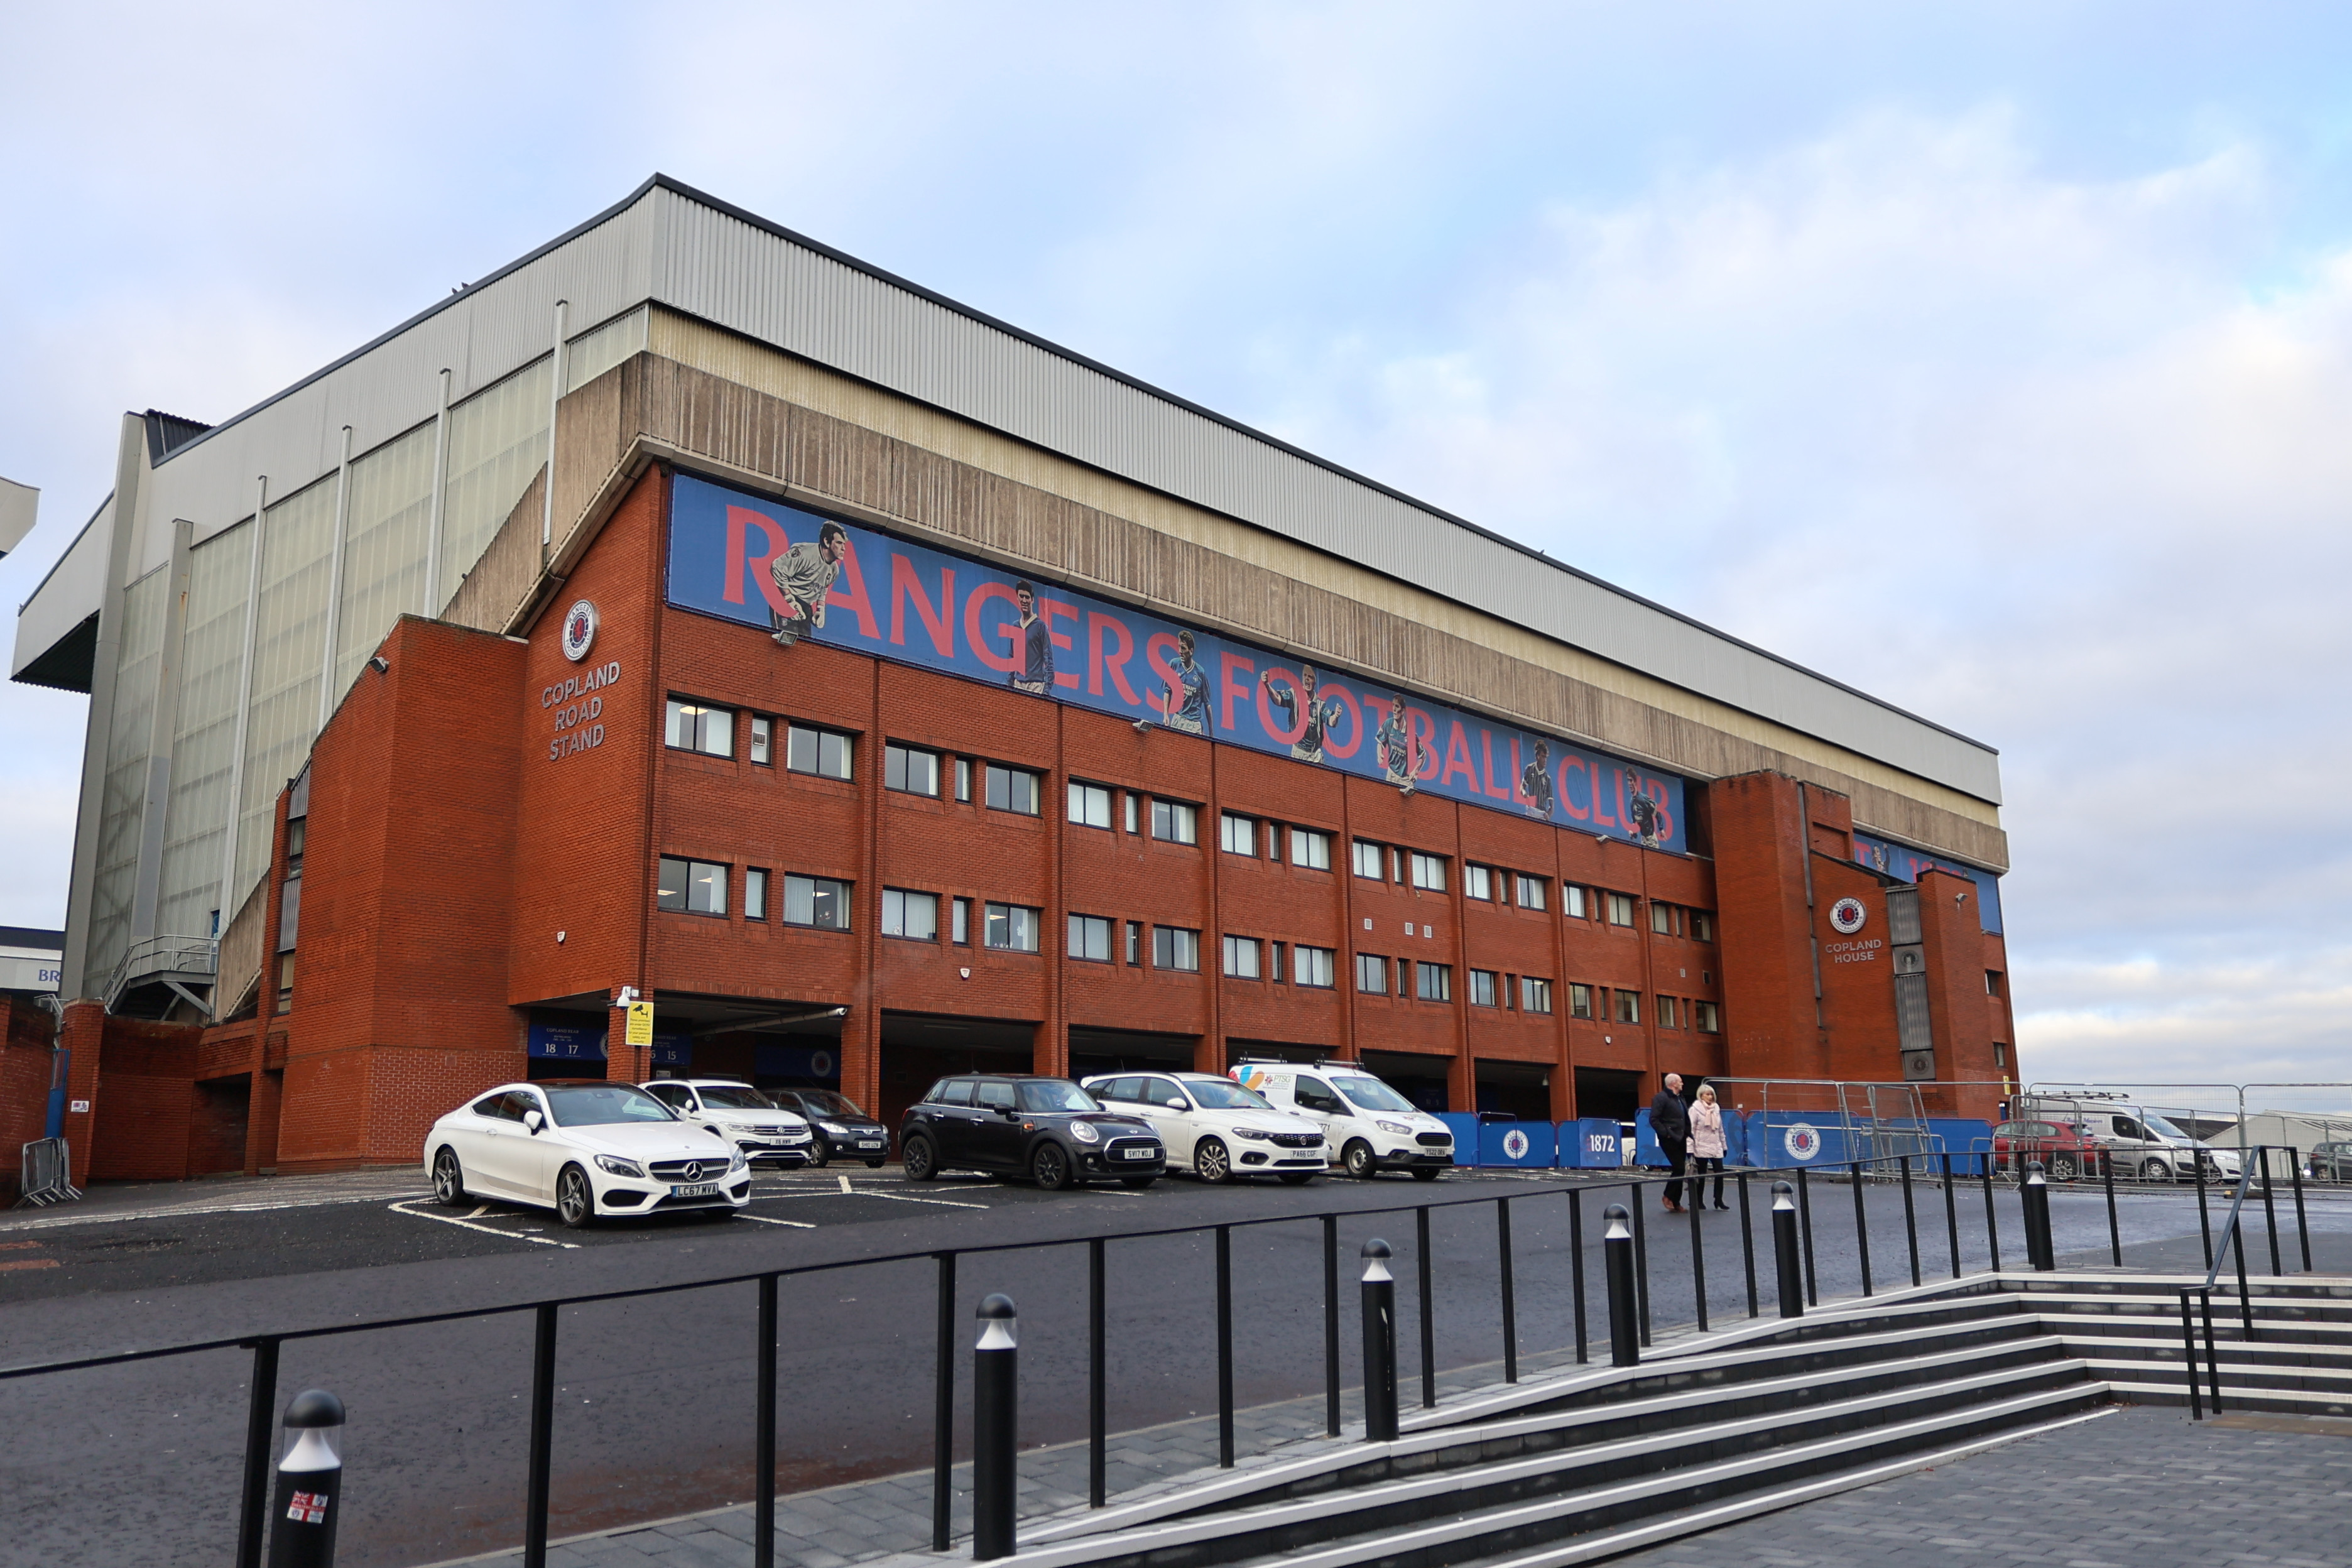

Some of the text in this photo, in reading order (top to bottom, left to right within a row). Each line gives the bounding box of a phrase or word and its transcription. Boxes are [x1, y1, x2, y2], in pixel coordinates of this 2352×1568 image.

[568, 604, 591, 624] RANGERS
[722, 504, 1673, 841] RANGERS FOOTBALL CLUB
[542, 662, 620, 708] COPLAND
[555, 697, 602, 731] ROAD
[550, 724, 605, 761] STAND
[1835, 899, 1859, 910] RANGERS
[1834, 918, 1855, 930] FOOTBALL
[1825, 939, 1882, 953] COPLAND
[1834, 951, 1875, 963] HOUSE
[545, 1043, 556, 1054] 18
[568, 1045, 579, 1055] 17
[667, 1050, 677, 1060] 15
[1273, 1075, 1291, 1083] PTSG
[1590, 1135, 1614, 1152] 1872
[678, 1185, 716, 1196] LC67 MVA
